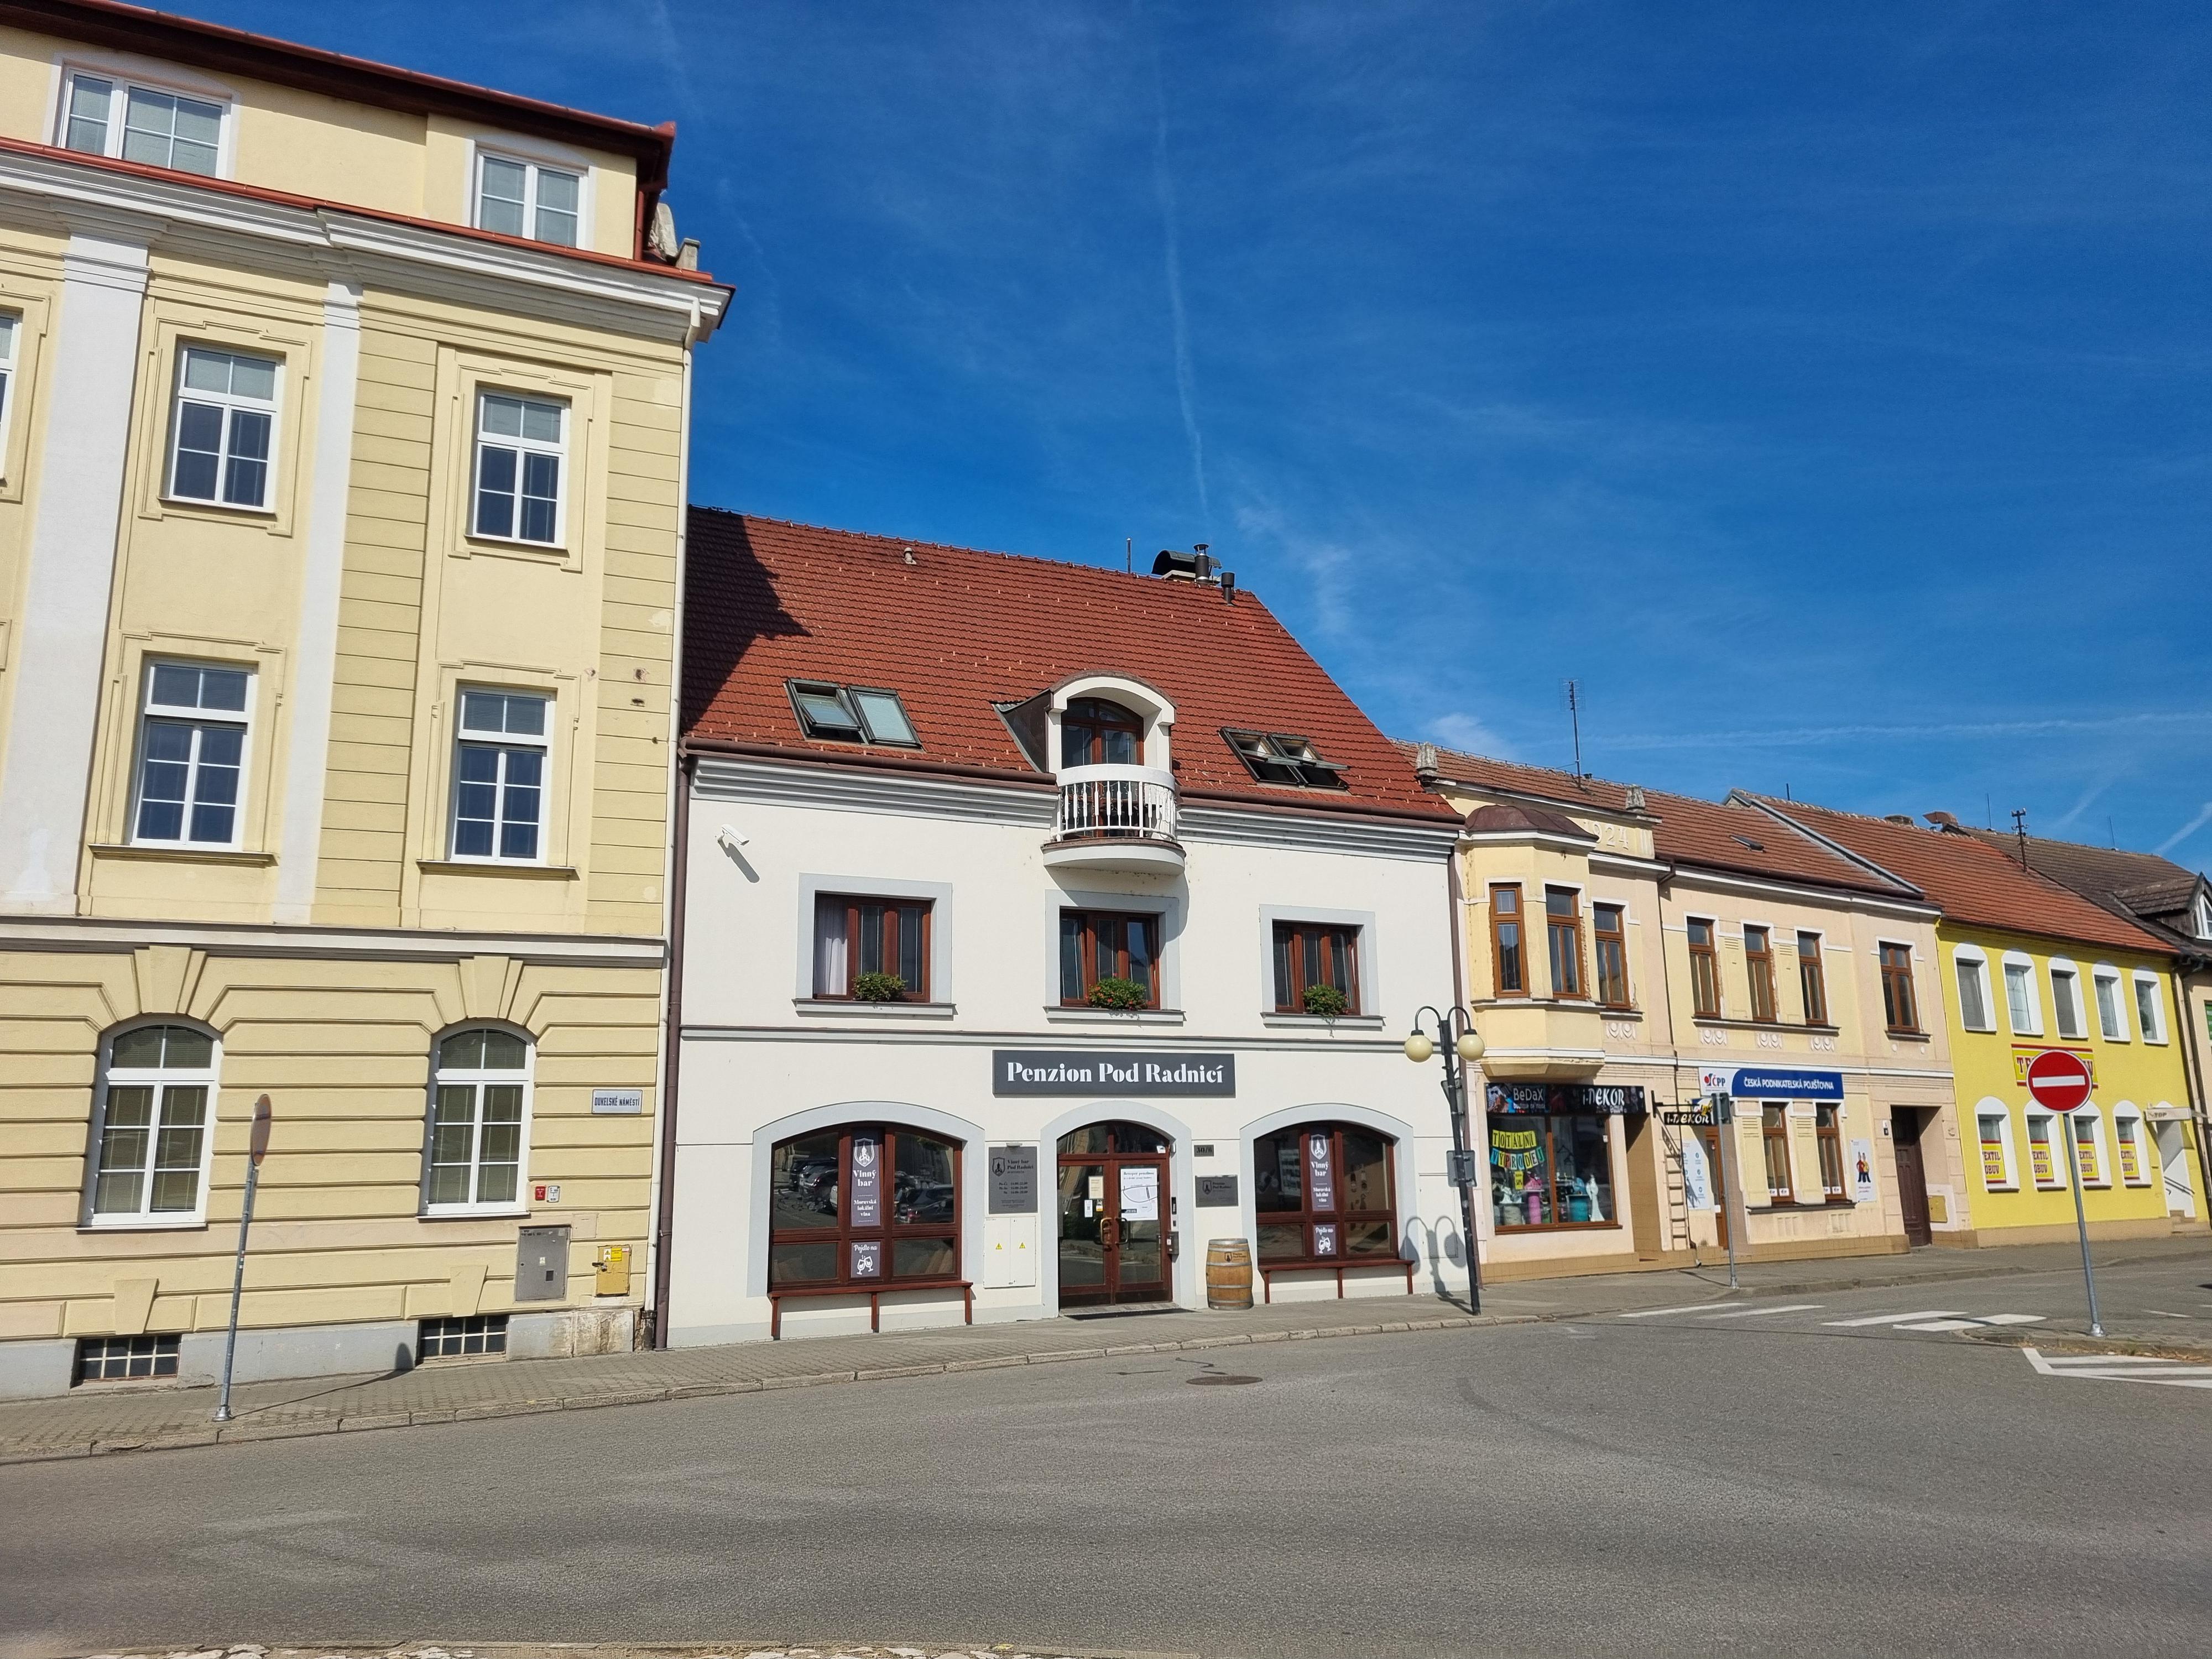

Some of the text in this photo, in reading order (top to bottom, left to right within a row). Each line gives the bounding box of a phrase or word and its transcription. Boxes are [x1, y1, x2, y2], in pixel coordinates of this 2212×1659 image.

[1007, 1062, 1225, 1083] Penzion Pod Radnicí
[1712, 1074, 1726, 1087] ČPP
[1744, 1077, 1834, 1090] ČESKÁ PODNIKATELSKÁ POJIŠŤOVNA
[1513, 1088, 1544, 1101] BeDaX
[594, 1095, 640, 1106] DUKELSKÉ NÁMĚSTÍ
[1983, 1151, 2001, 1161] EXTIL
[1311, 1161, 1329, 1170] Vinný
[853, 1170, 877, 1179] Vinný
[858, 1178, 873, 1187] bar
